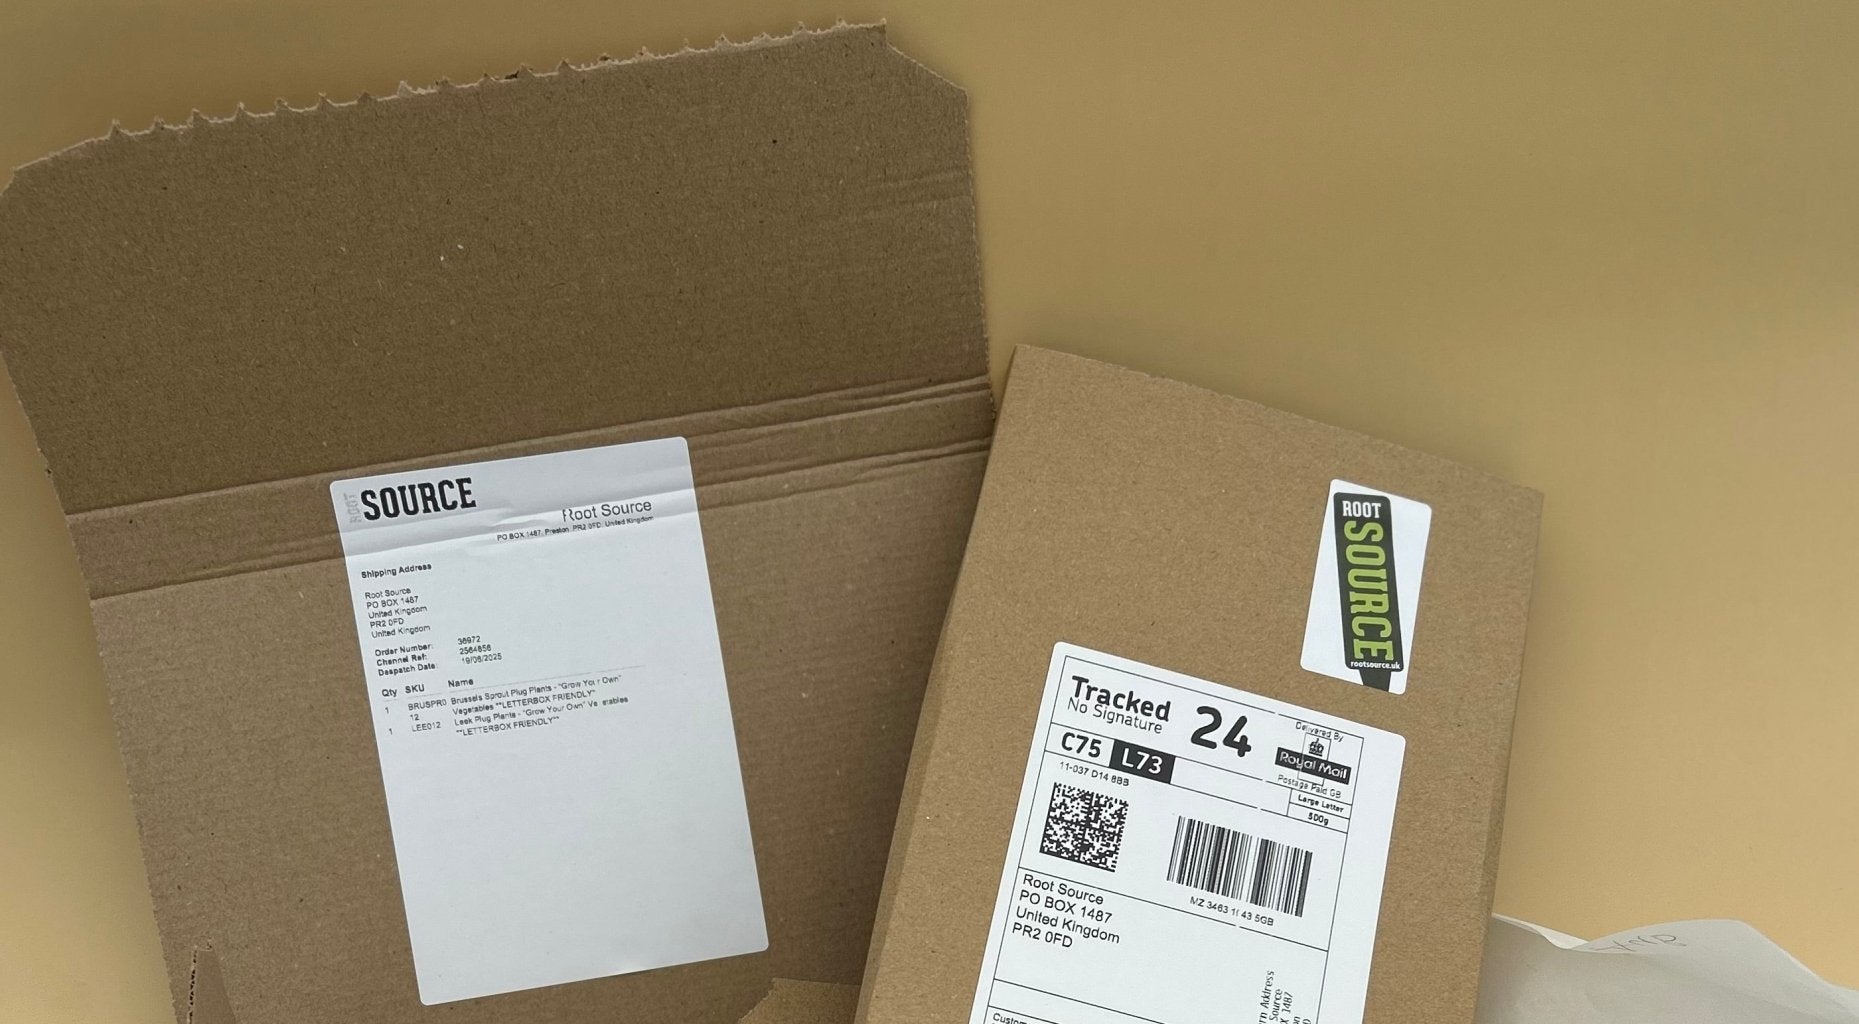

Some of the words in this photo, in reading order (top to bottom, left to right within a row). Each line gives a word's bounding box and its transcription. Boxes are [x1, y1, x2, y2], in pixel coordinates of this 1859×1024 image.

[358, 476, 478, 522] SOURCE
[561, 504, 598, 523] Root
[1342, 500, 1382, 519] ROOT
[1343, 520, 1395, 661] SOURCE
[1350, 660, 1401, 670] rootsource.uk
[1070, 674, 1171, 722] Tracked
[1067, 696, 1088, 714] No
[1092, 703, 1162, 734] Signature
[1061, 731, 1102, 758] C75
[1190, 705, 1252, 758] 24
[1059, 761, 1090, 775] 11-037
[1090, 769, 1109, 781] D14
[1120, 746, 1164, 776] L73
[1278, 750, 1317, 773] Royal
[1317, 761, 1348, 780] Mail
[1297, 793, 1320, 806] Large
[1321, 800, 1344, 813] Letter
[1307, 811, 1329, 826] 500g
[1022, 873, 1055, 892] Root
[1057, 882, 1104, 905] Source
[1019, 888, 1041, 905] PO
[1043, 895, 1077, 915] BOX
[1080, 905, 1113, 924] 1487
[1189, 895, 1205, 908] MZ
[1206, 900, 1229, 914] 3463
[1254, 913, 1274, 926] 5GB
[1011, 921, 1042, 940] PR2
[1044, 930, 1073, 948] 0FD
[1015, 905, 1059, 927] United
[1061, 917, 1120, 944] Kingdom
[1259, 970, 1274, 1009] Address
[1281, 991, 1293, 1014] 1487
[1268, 988, 1283, 1022] Source
